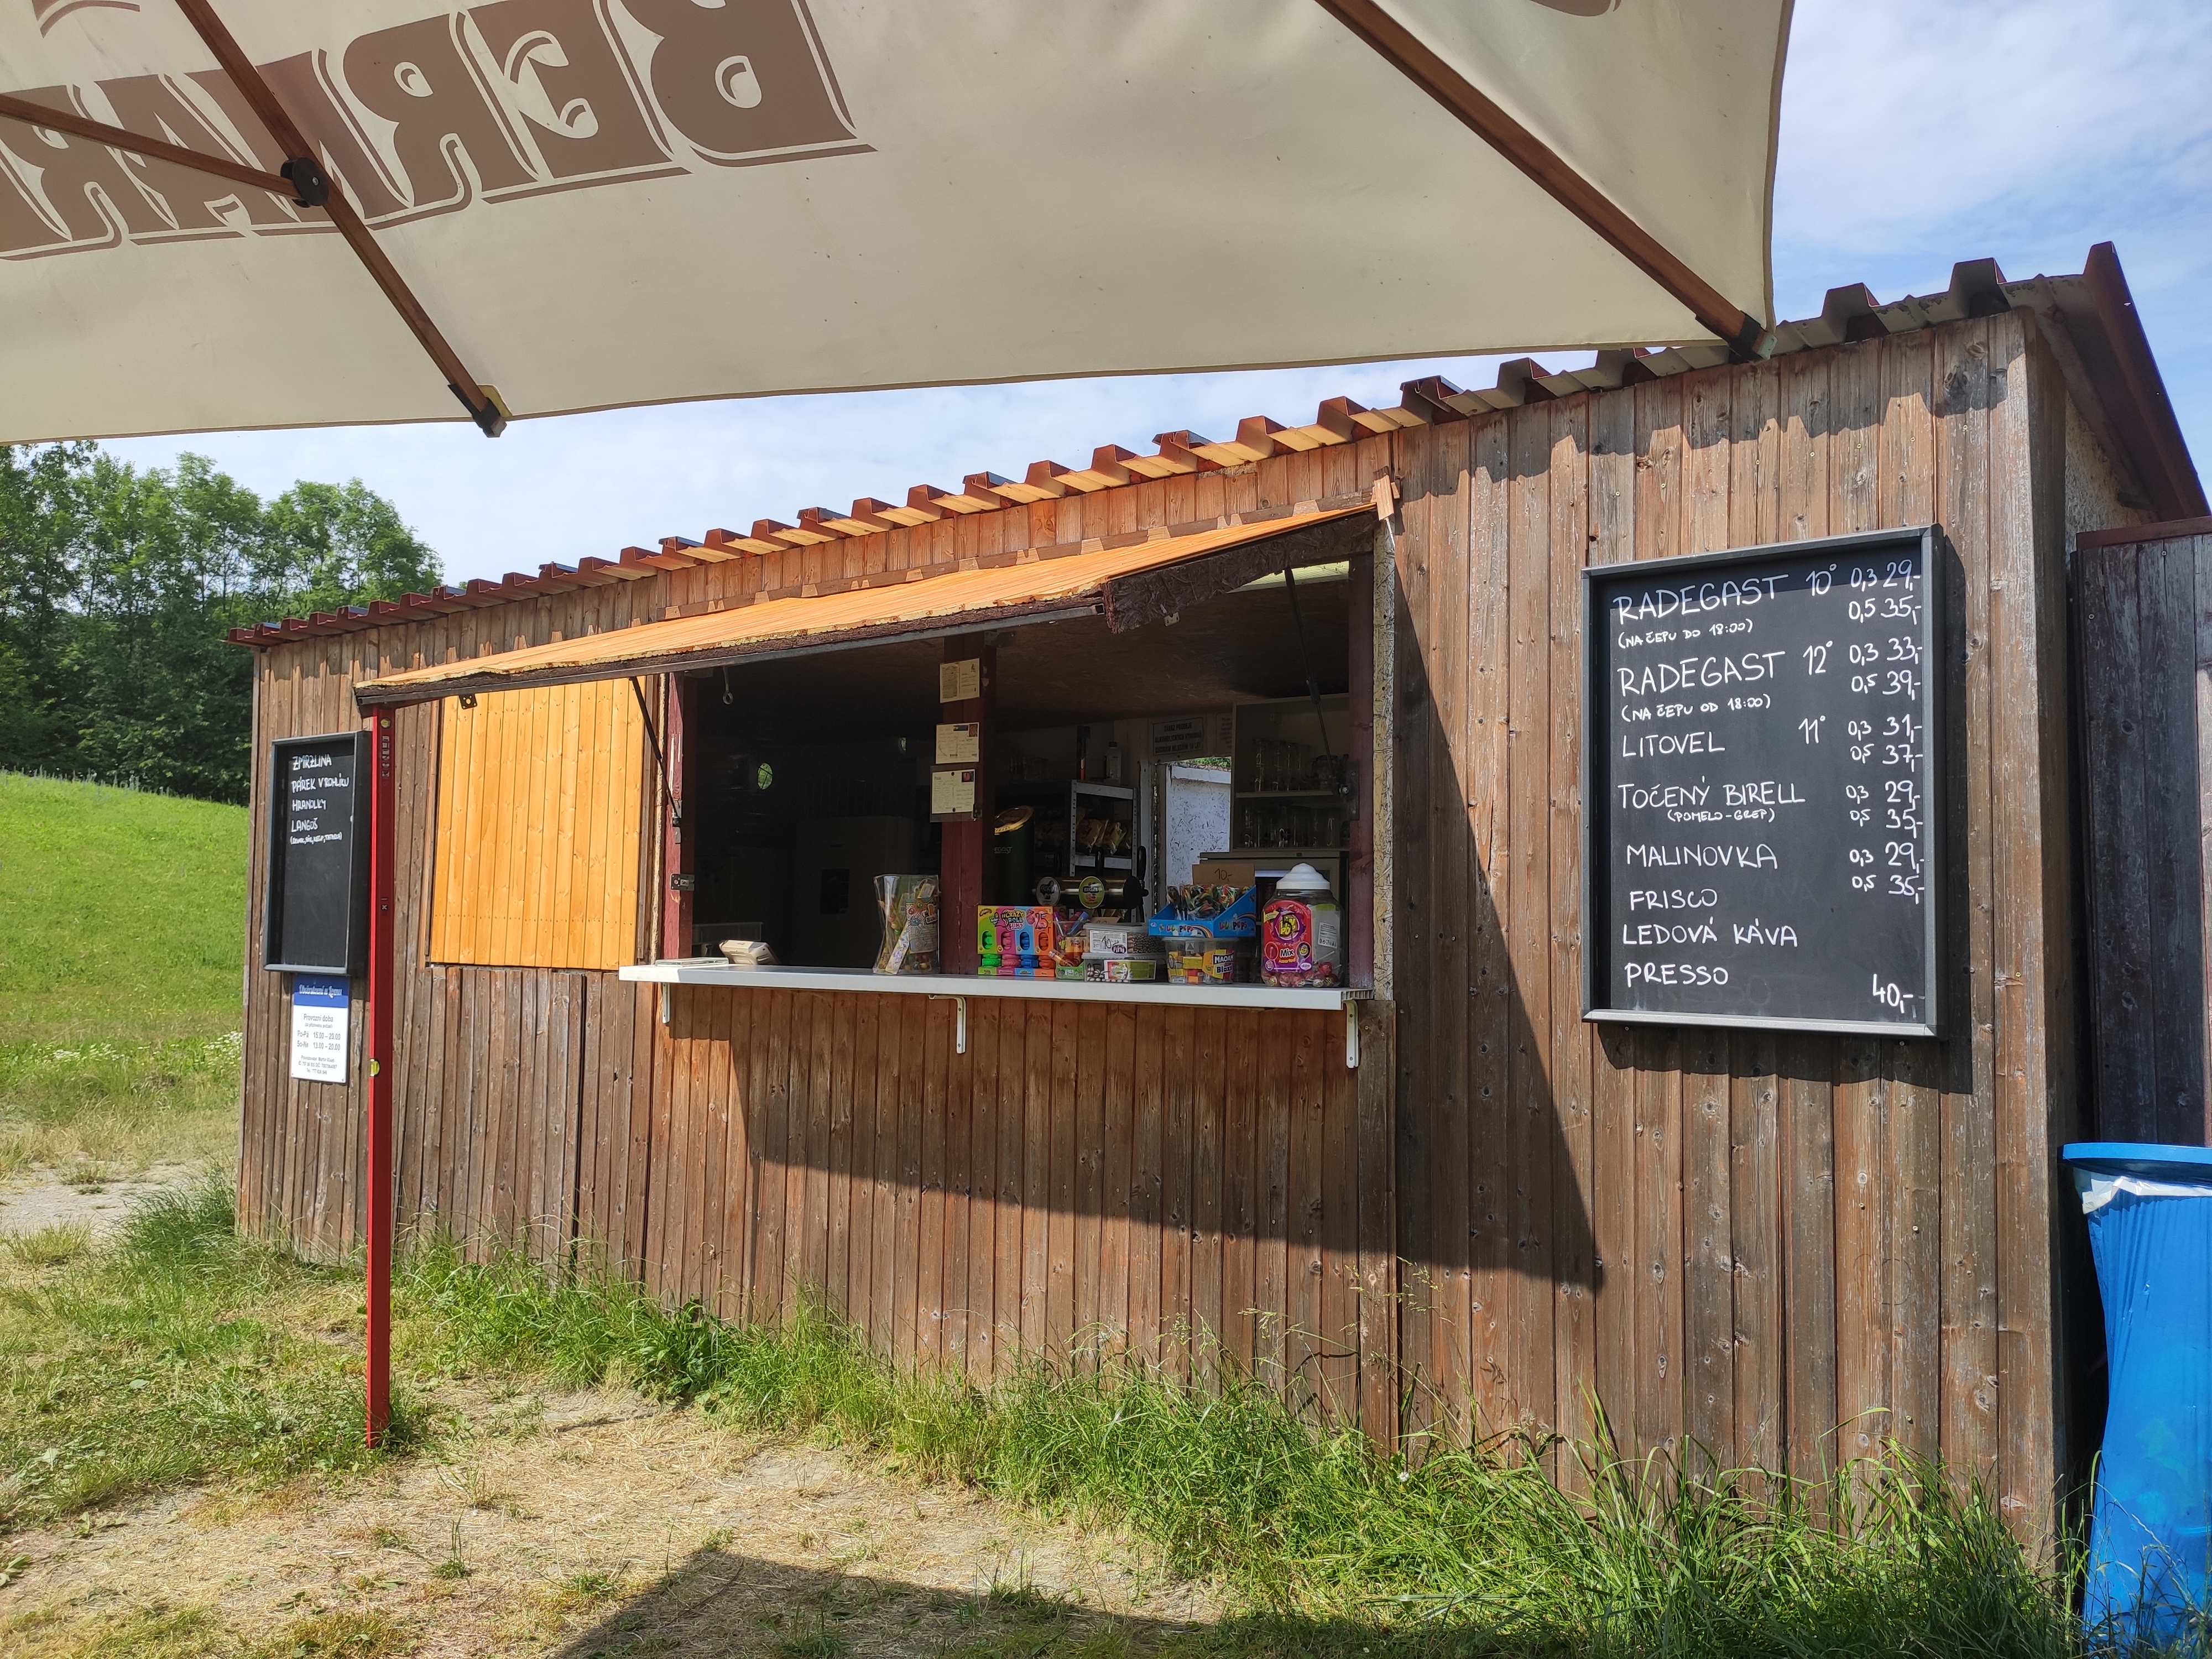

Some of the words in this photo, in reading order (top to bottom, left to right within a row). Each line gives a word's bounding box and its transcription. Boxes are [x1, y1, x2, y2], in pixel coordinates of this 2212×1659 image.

[1613, 574, 1788, 625] RADEGAST
[1851, 567, 1877, 588] 0,3
[1849, 598, 1876, 623] 0,5
[1618, 633, 1643, 648] (NA
[1646, 630, 1677, 643] ČEPU
[1685, 628, 1700, 640] DO
[1709, 619, 1753, 636] 18:00)
[1617, 651, 1785, 696] RADEGAST
[1850, 644, 1879, 665] 0,3
[1851, 674, 1878, 693] 0,5
[1621, 704, 1651, 721] (NA
[1657, 703, 1693, 718] ČEPU
[1700, 702, 1718, 713] OD
[1728, 695, 1771, 711] 18:00)
[1623, 732, 1725, 757] LITOVEL
[1848, 721, 1871, 740] 0,3
[293, 754, 332, 771] ZMRZLINA
[1850, 744, 1874, 763] 0,5
[291, 776, 316, 794] PÁREK
[1617, 776, 1709, 809] TOČENÝ
[1723, 781, 1806, 806] BIRELL
[1846, 785, 1869, 804] 0,3
[292, 799, 327, 812] HRANOLKY
[291, 817, 319, 833] LANGOŠ
[1850, 810, 1870, 826] 0,5
[1627, 844, 1778, 869] MALINOVKA
[1849, 849, 1874, 867] 0,3
[1851, 874, 1877, 891] 0,5
[1630, 888, 1717, 911] FRISCO
[1623, 916, 1718, 946] LEDOVÁ
[1734, 918, 1798, 947] KÁVA
[1214, 954, 1234, 964] MAOAM
[1280, 948, 1294, 957] Mix
[1624, 963, 1728, 988] PRESSO
